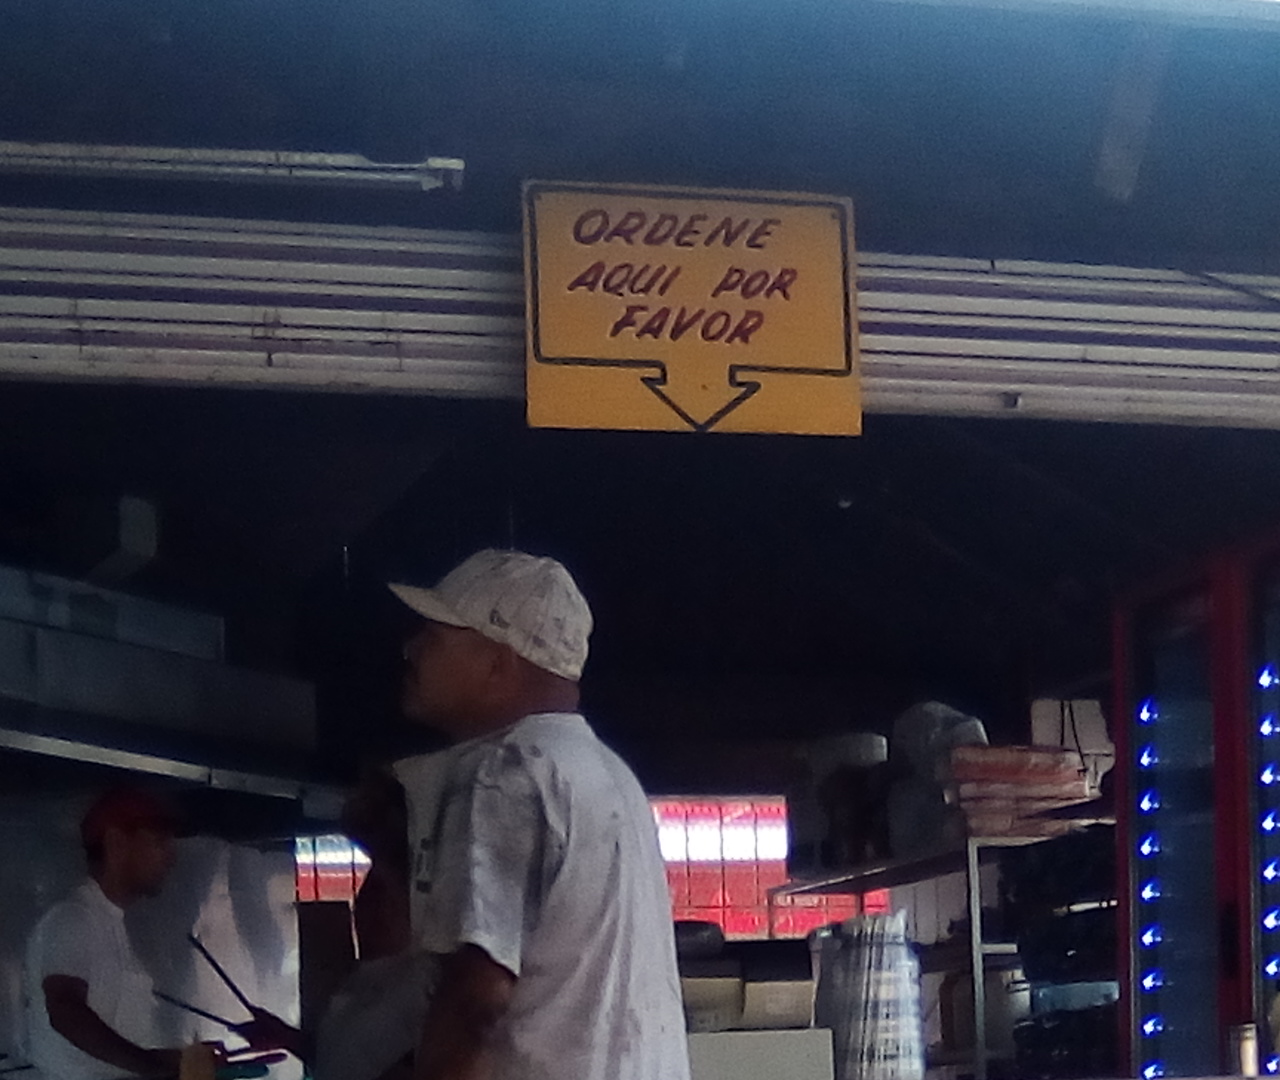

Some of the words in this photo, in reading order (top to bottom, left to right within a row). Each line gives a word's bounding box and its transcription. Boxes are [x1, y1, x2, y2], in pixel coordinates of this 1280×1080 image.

[573, 209, 782, 249] ORDENE
[567, 261, 681, 297] AQUI
[711, 267, 798, 300] POR
[610, 305, 765, 344] FAVOR
